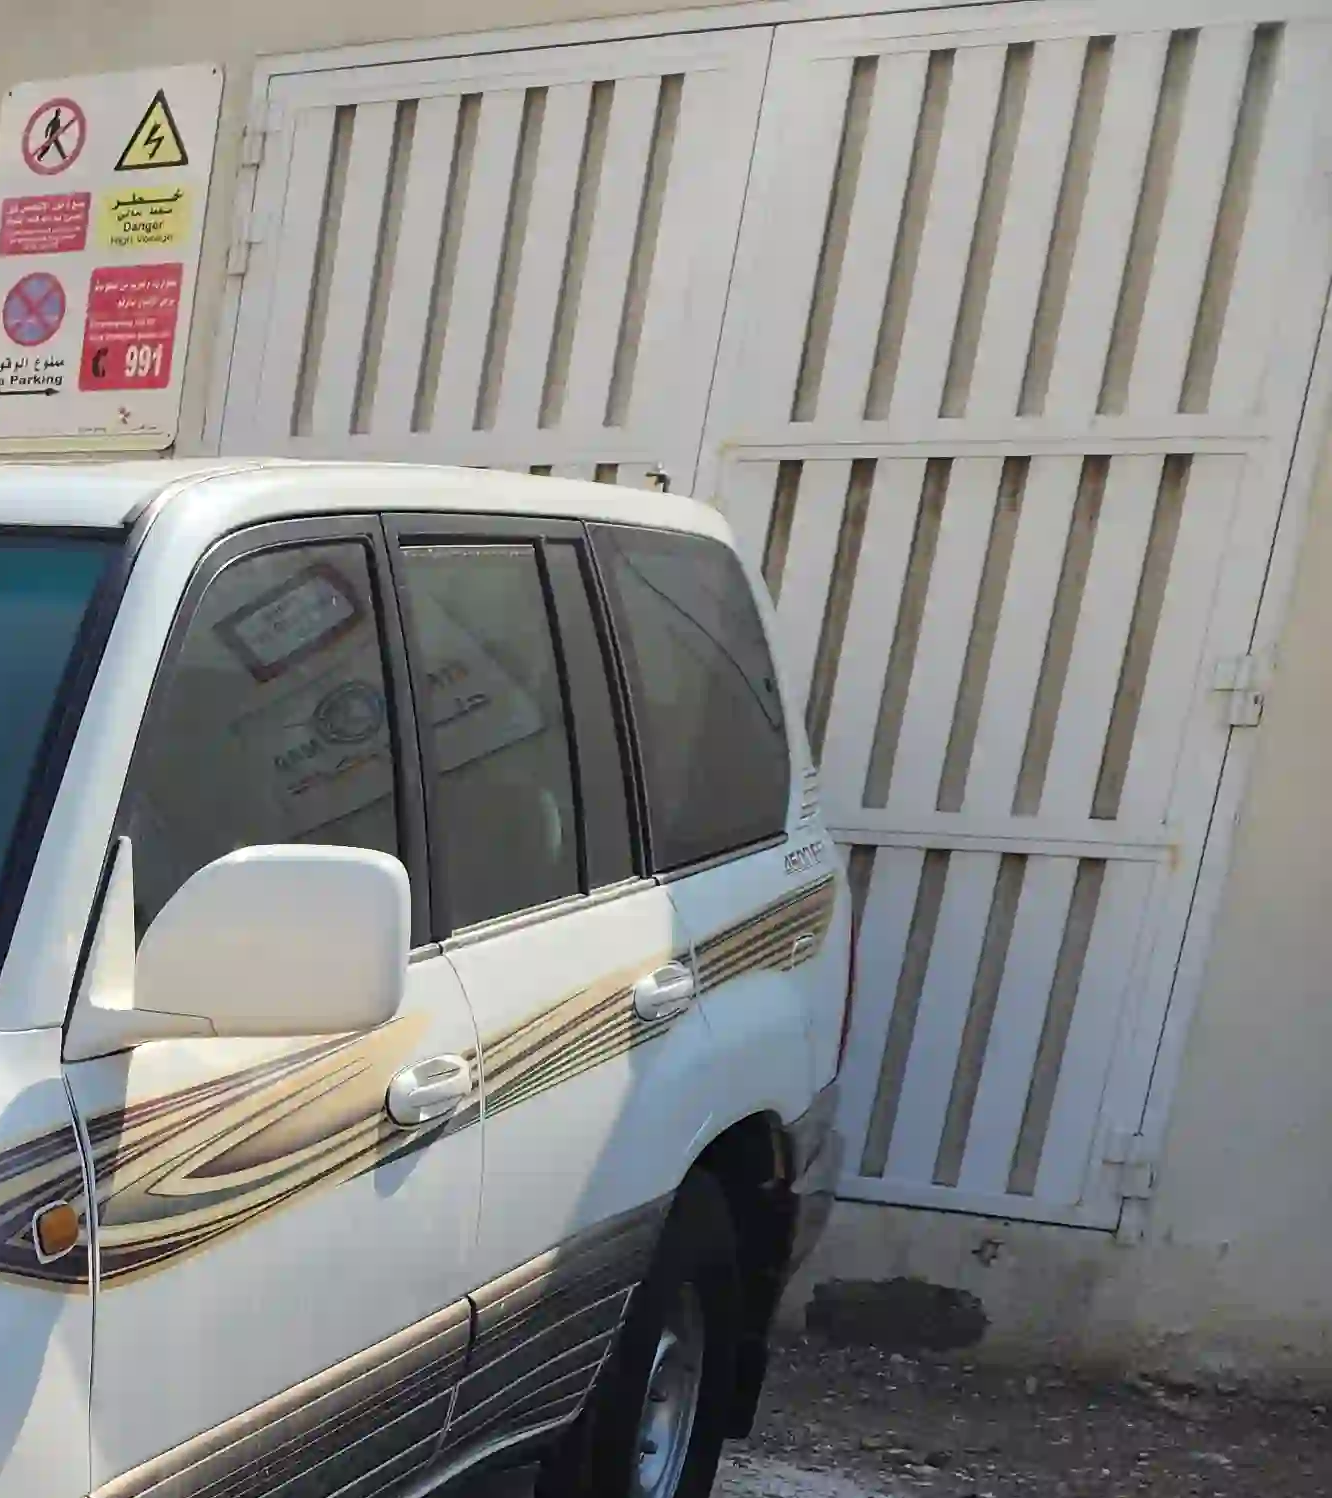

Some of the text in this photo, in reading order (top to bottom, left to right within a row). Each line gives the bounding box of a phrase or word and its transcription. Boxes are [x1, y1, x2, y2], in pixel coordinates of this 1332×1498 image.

[123, 220, 165, 233] Danger
[124, 343, 164, 377] 991
[10, 375, 63, 386] Parking
